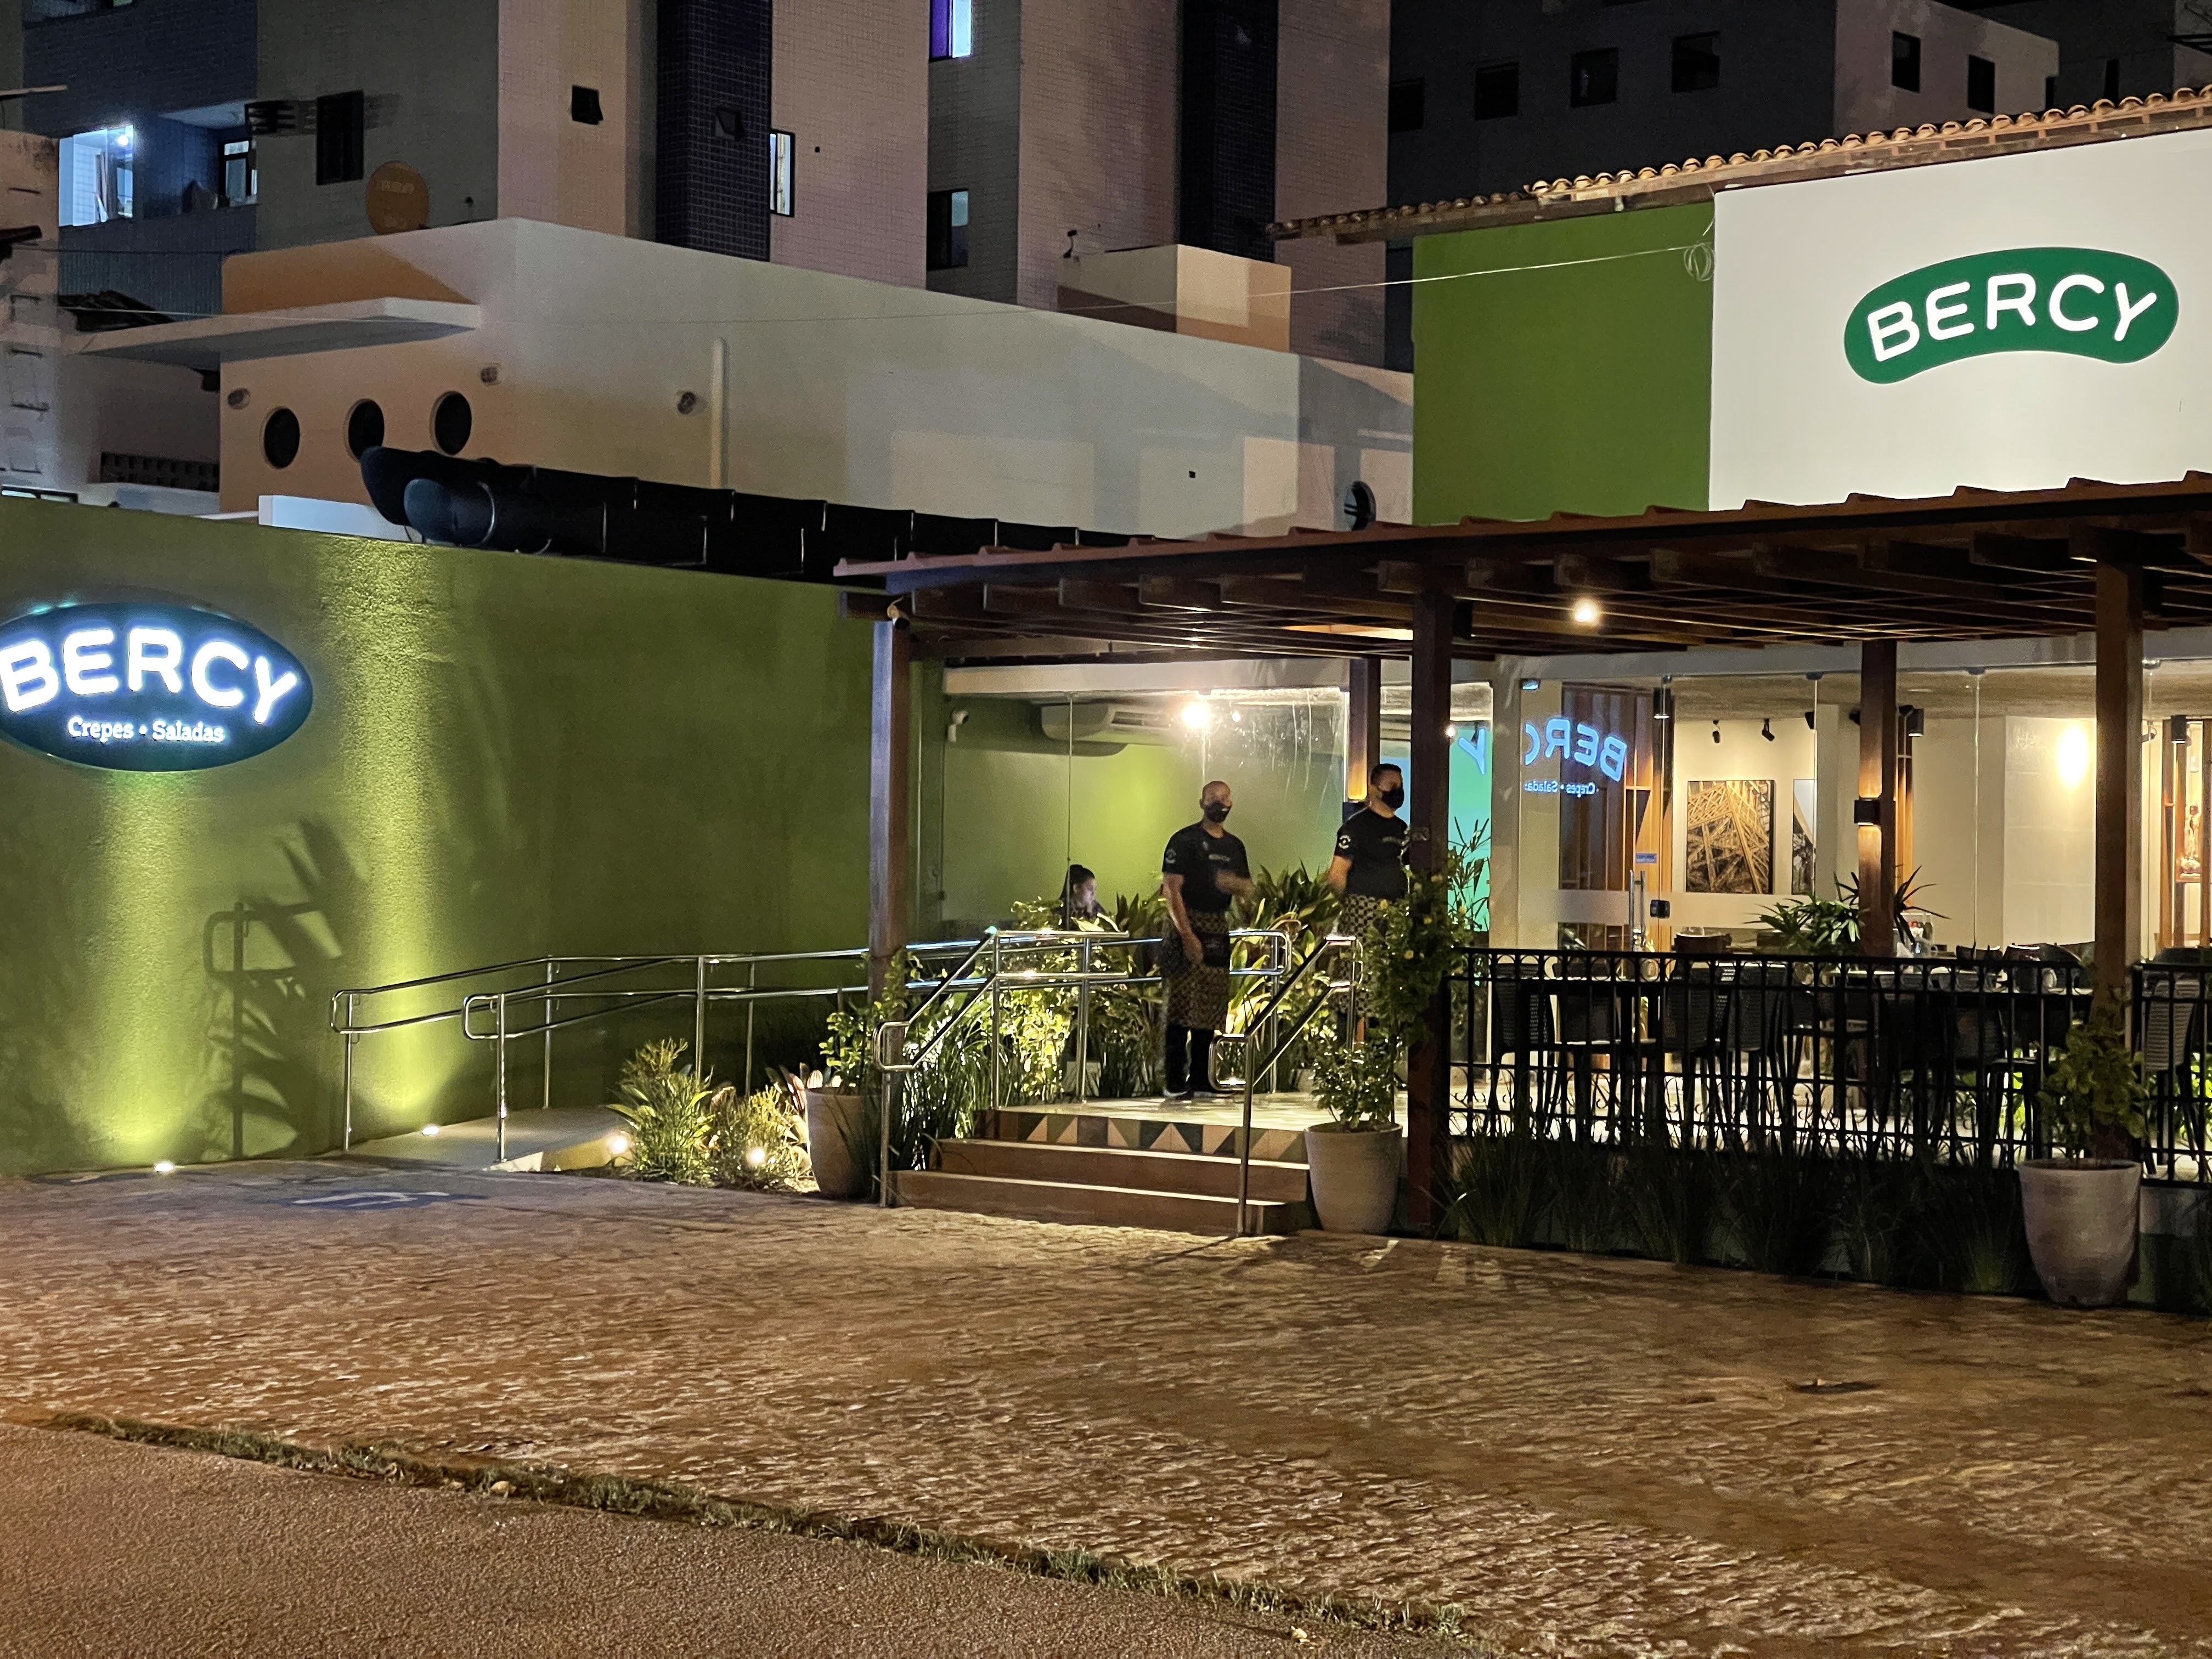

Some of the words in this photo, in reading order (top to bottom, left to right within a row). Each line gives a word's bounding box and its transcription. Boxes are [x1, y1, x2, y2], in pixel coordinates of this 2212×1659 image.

[1867, 272, 2158, 363] BERCY
[0, 627, 297, 725] BERCY
[67, 716, 134, 743] Crepes
[152, 719, 225, 743] Saladas
